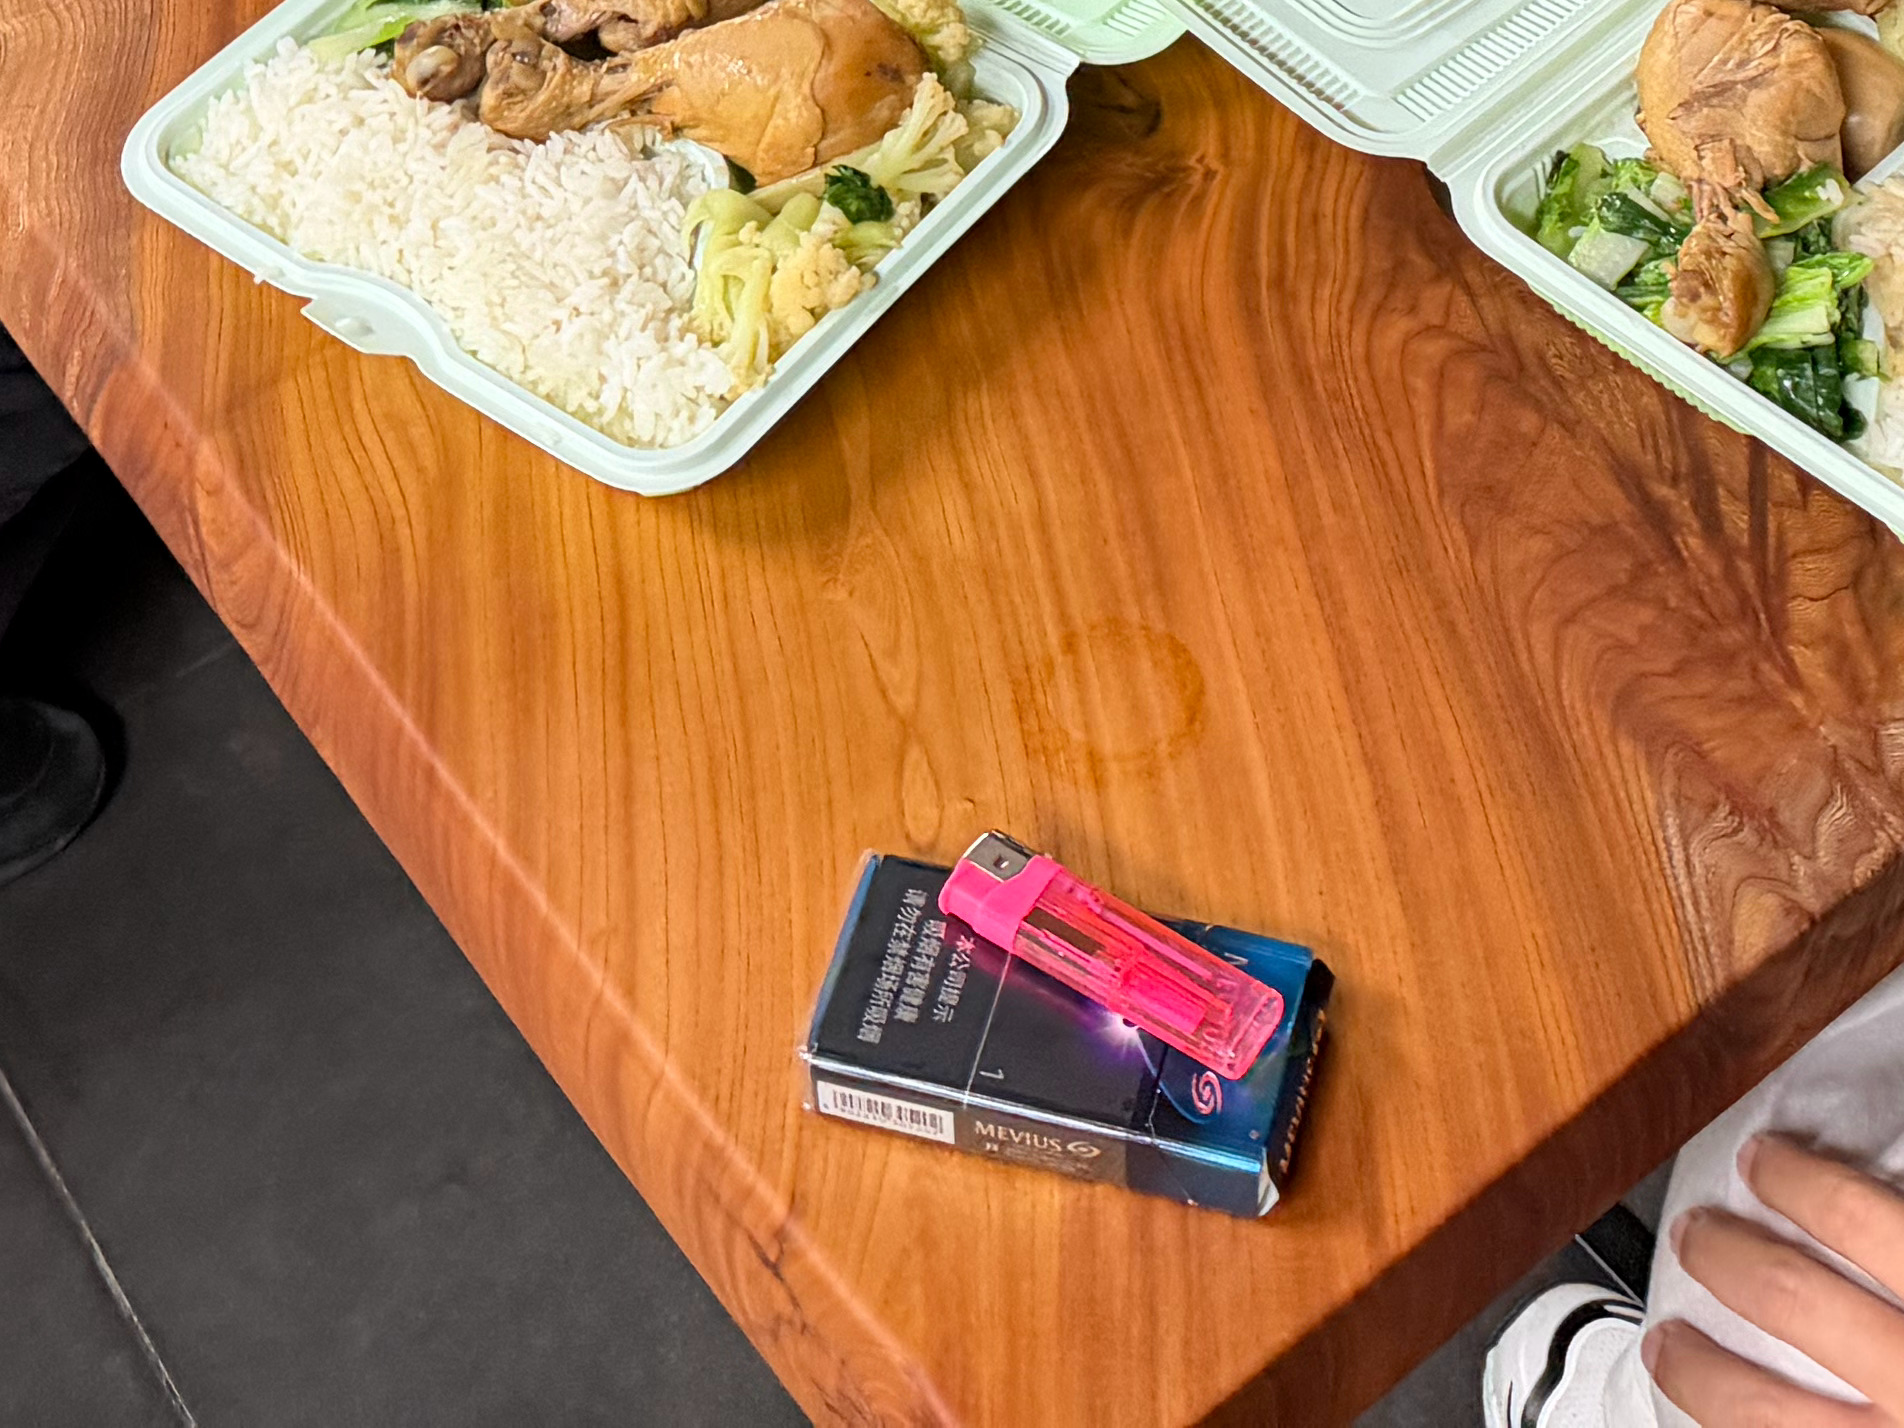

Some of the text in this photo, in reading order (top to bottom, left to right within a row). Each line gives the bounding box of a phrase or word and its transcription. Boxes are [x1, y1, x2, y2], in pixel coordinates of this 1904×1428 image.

[856, 888, 928, 1045] 请勿在禁烟场所吸烟
[894, 919, 946, 1024] 吸烟有害健康
[975, 1120, 1063, 1153] MEVIUS
